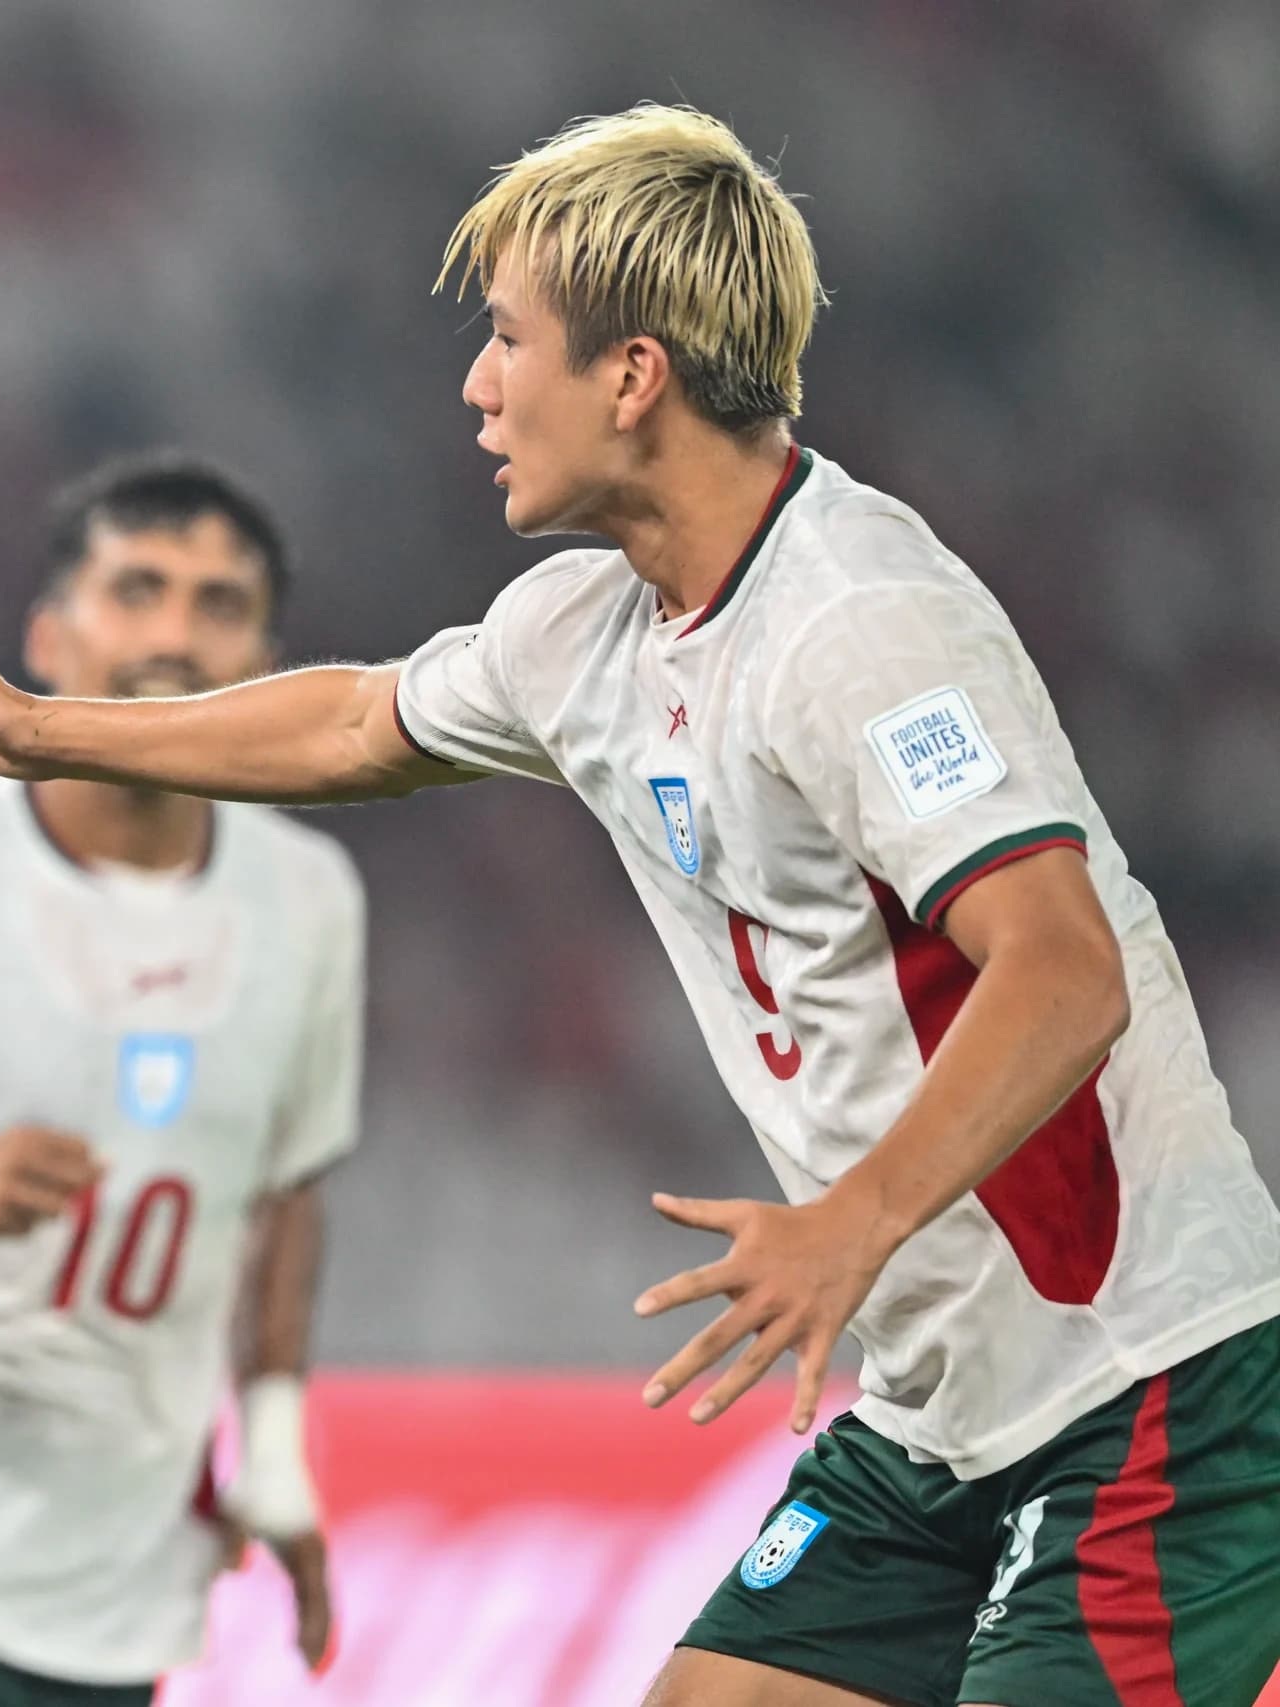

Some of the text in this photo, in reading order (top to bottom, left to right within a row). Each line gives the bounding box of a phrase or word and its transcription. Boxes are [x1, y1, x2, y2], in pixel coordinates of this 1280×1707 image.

[890, 708, 956, 748] FOOTBALL
[898, 724, 967, 769] UNITES
[910, 744, 981, 790] the World
[936, 773, 965, 792] FIFA
[52, 1170, 197, 1324] 10
